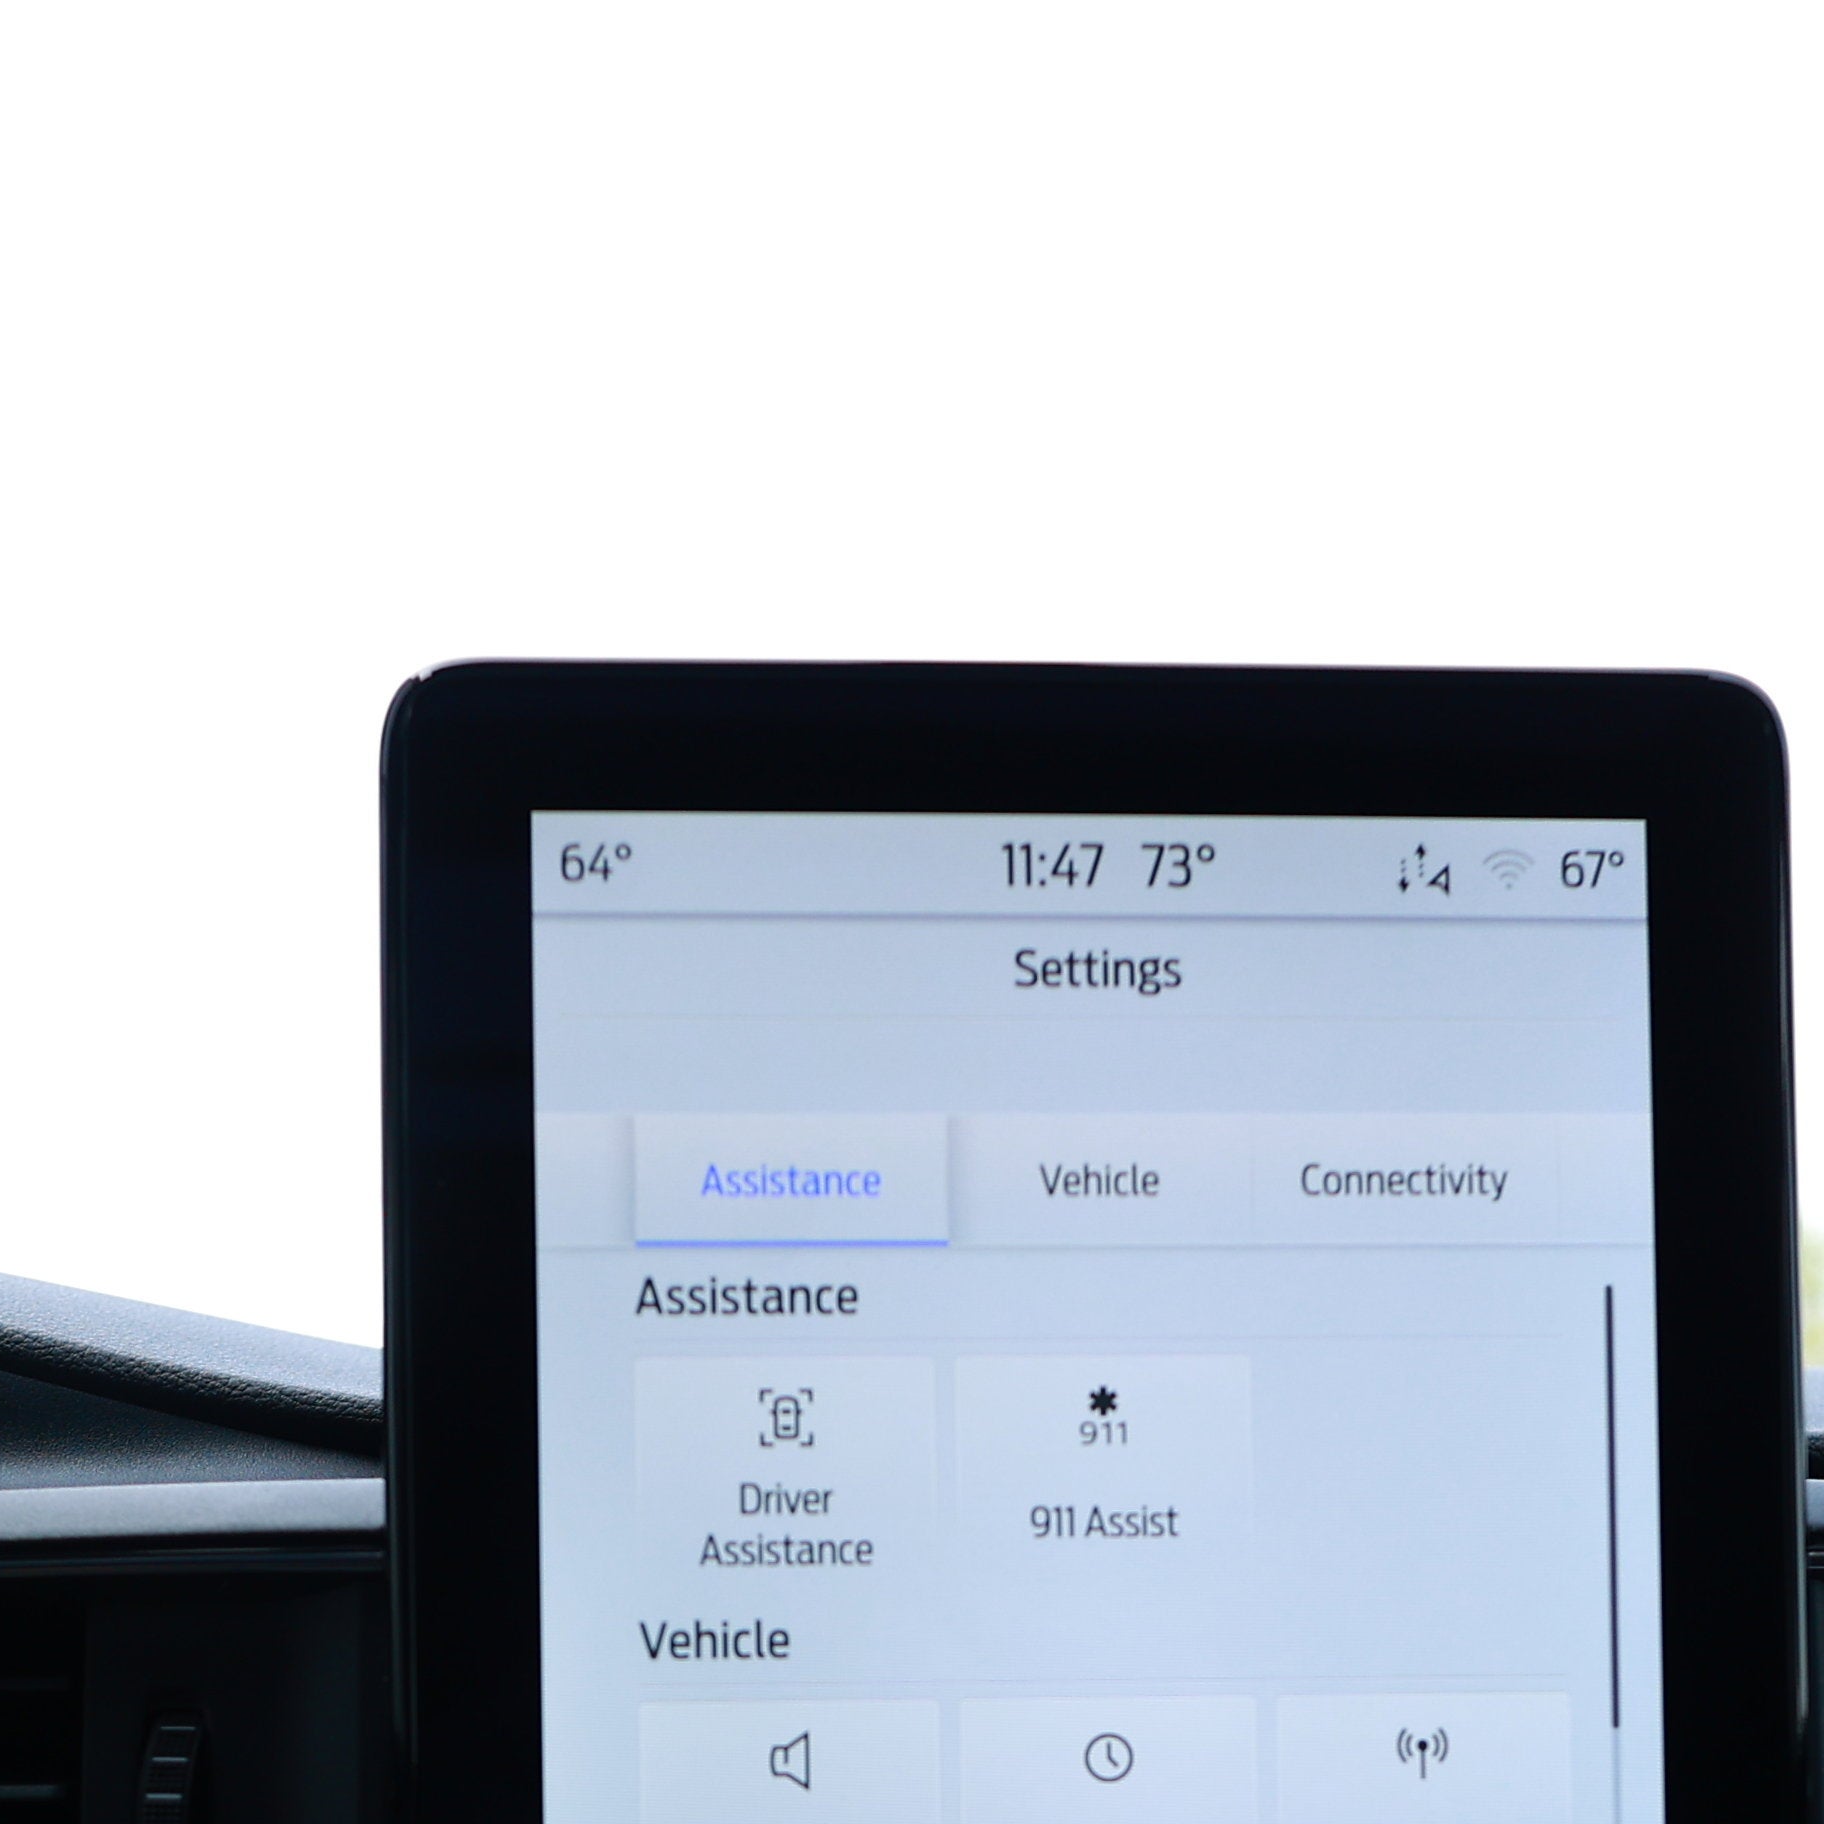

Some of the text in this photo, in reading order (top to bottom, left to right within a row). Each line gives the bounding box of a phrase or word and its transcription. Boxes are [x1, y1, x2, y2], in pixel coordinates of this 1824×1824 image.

[561, 844, 631, 882] 64°
[1003, 843, 1215, 888] 11:47 73°
[1561, 851, 1624, 888] 67°
[1015, 949, 1181, 995] Settings
[702, 1164, 881, 1196] Assistance
[1040, 1164, 1159, 1196] Vehicle
[1301, 1164, 1507, 1202] Connectivity
[636, 1277, 858, 1315] Assistance
[1079, 1421, 1127, 1446] 911
[740, 1483, 832, 1515] Driver
[1031, 1505, 1178, 1538] 911 Assist
[700, 1534, 873, 1566] Assistance
[640, 1620, 789, 1659] Vehicle
